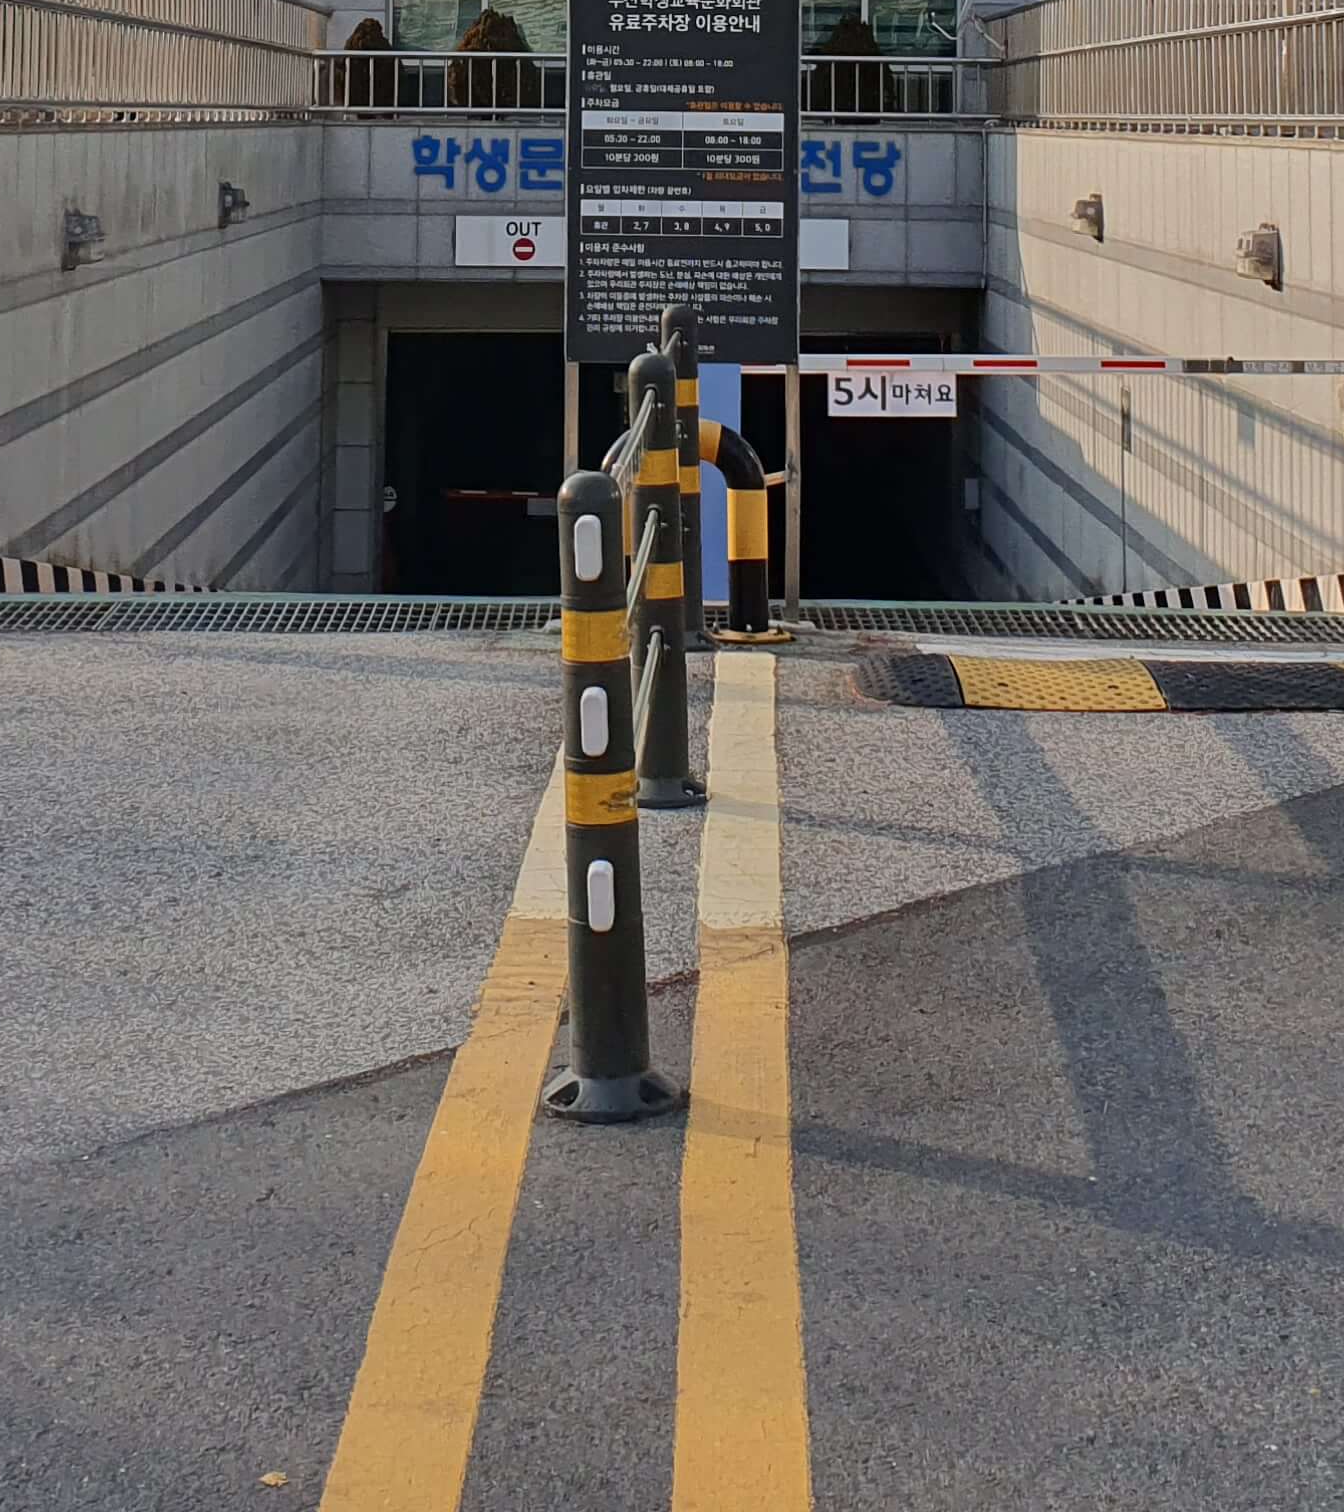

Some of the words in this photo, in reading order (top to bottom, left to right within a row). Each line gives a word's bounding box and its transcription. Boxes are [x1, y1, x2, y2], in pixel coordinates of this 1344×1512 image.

[609, 14, 690, 32] 유료주차장
[696, 14, 760, 33] 이용안내
[412, 136, 565, 193] 학생문
[801, 140, 901, 196] 전당
[506, 221, 542, 237] OUT
[833, 375, 887, 411] 5시
